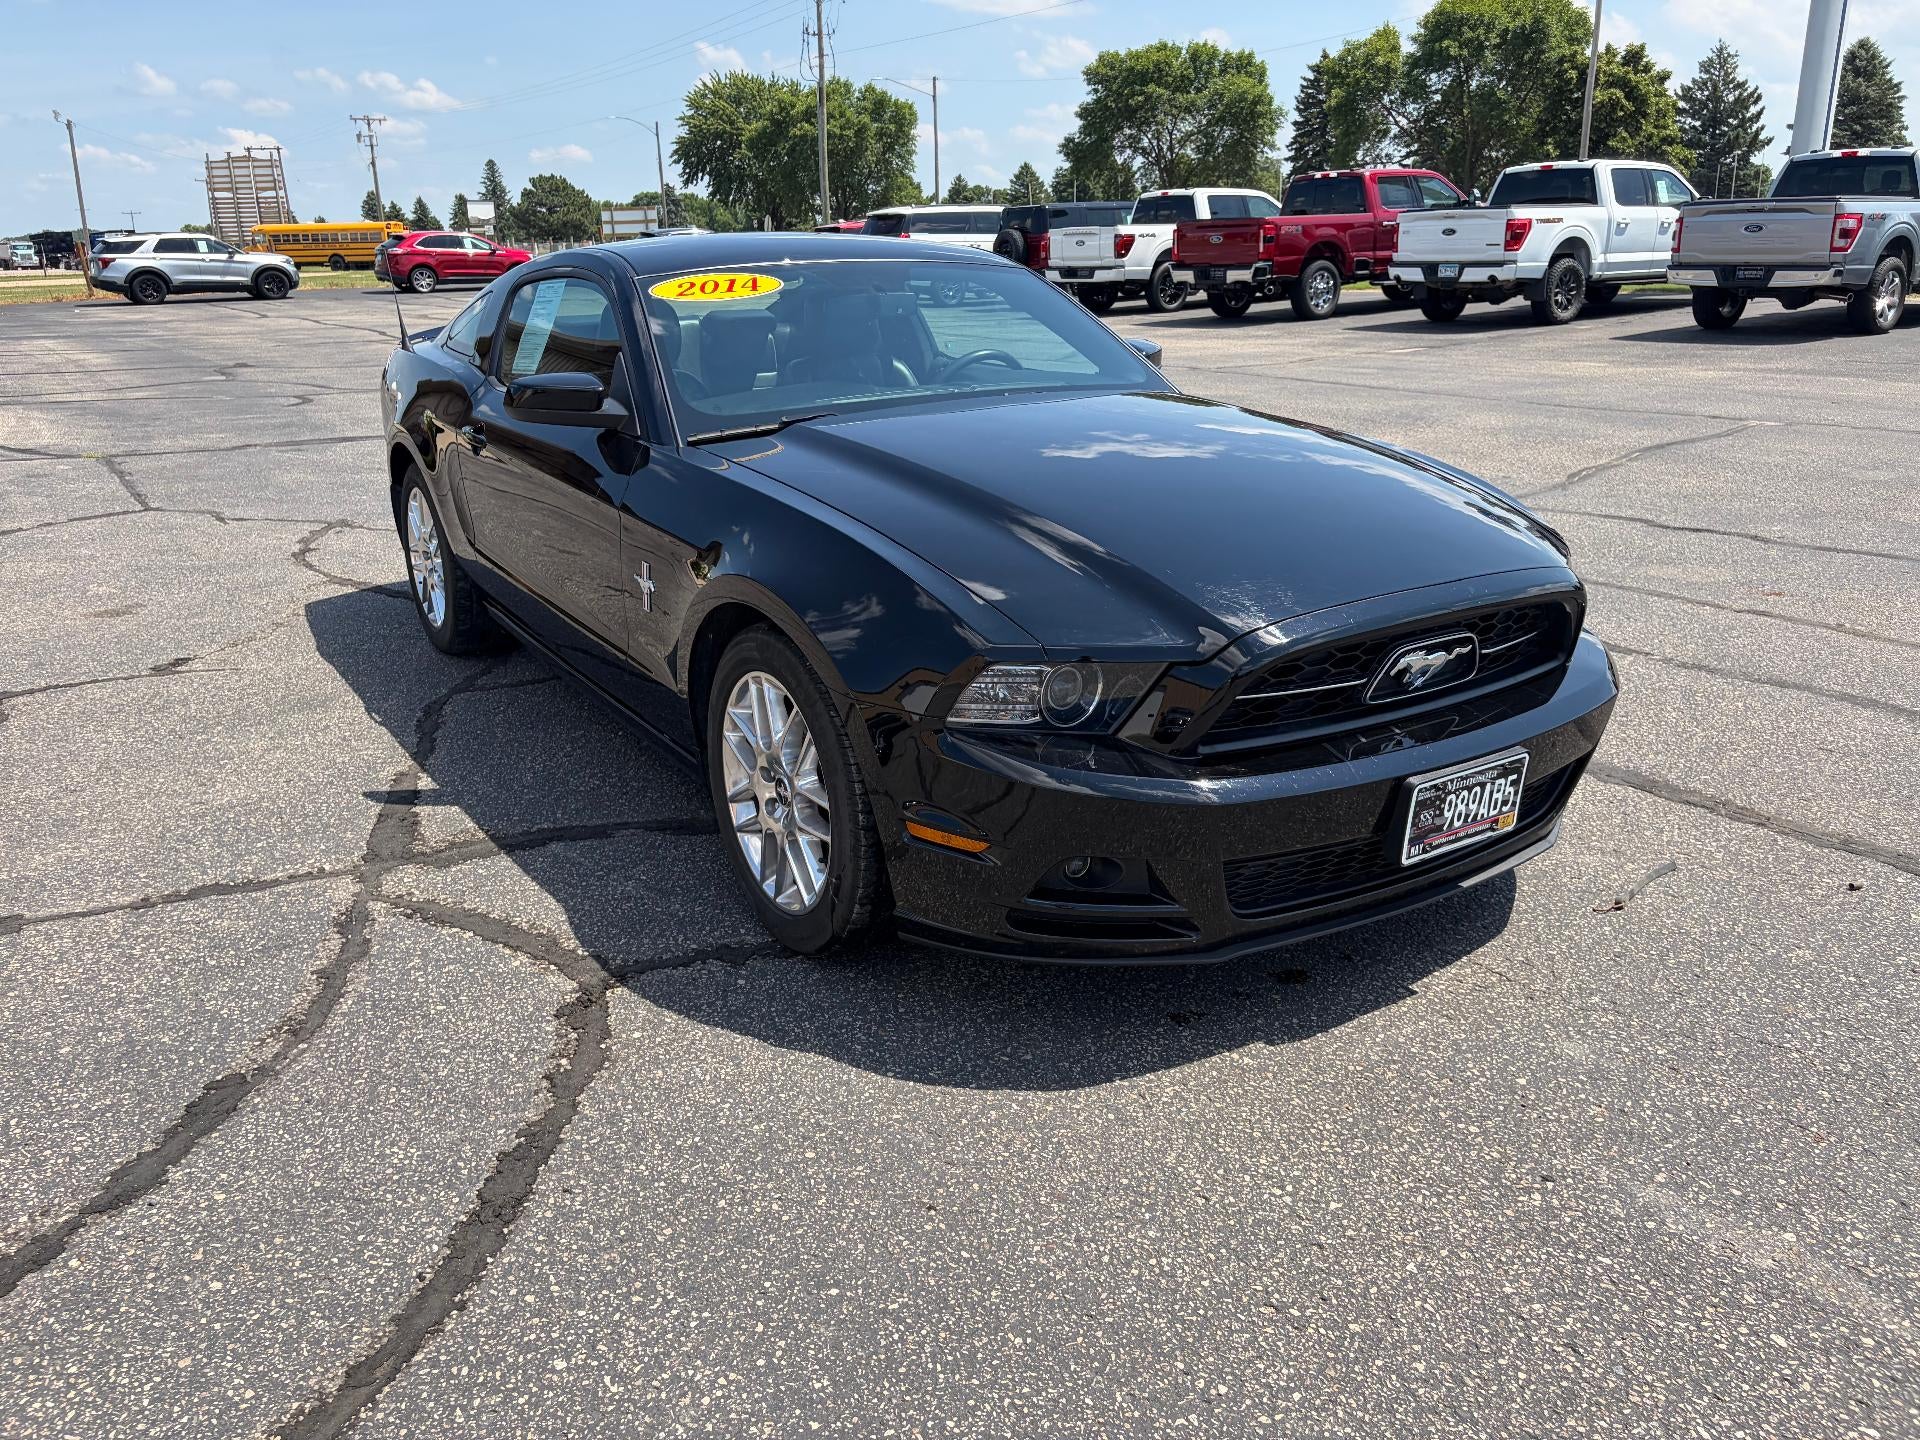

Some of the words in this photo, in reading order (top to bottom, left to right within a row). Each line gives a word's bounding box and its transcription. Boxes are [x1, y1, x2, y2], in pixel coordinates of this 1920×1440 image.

[675, 276, 762, 297] 2014
[1446, 769, 1498, 792] Minnesota
[1443, 774, 1518, 830] 989AB5
[1410, 843, 1424, 857] MAY
